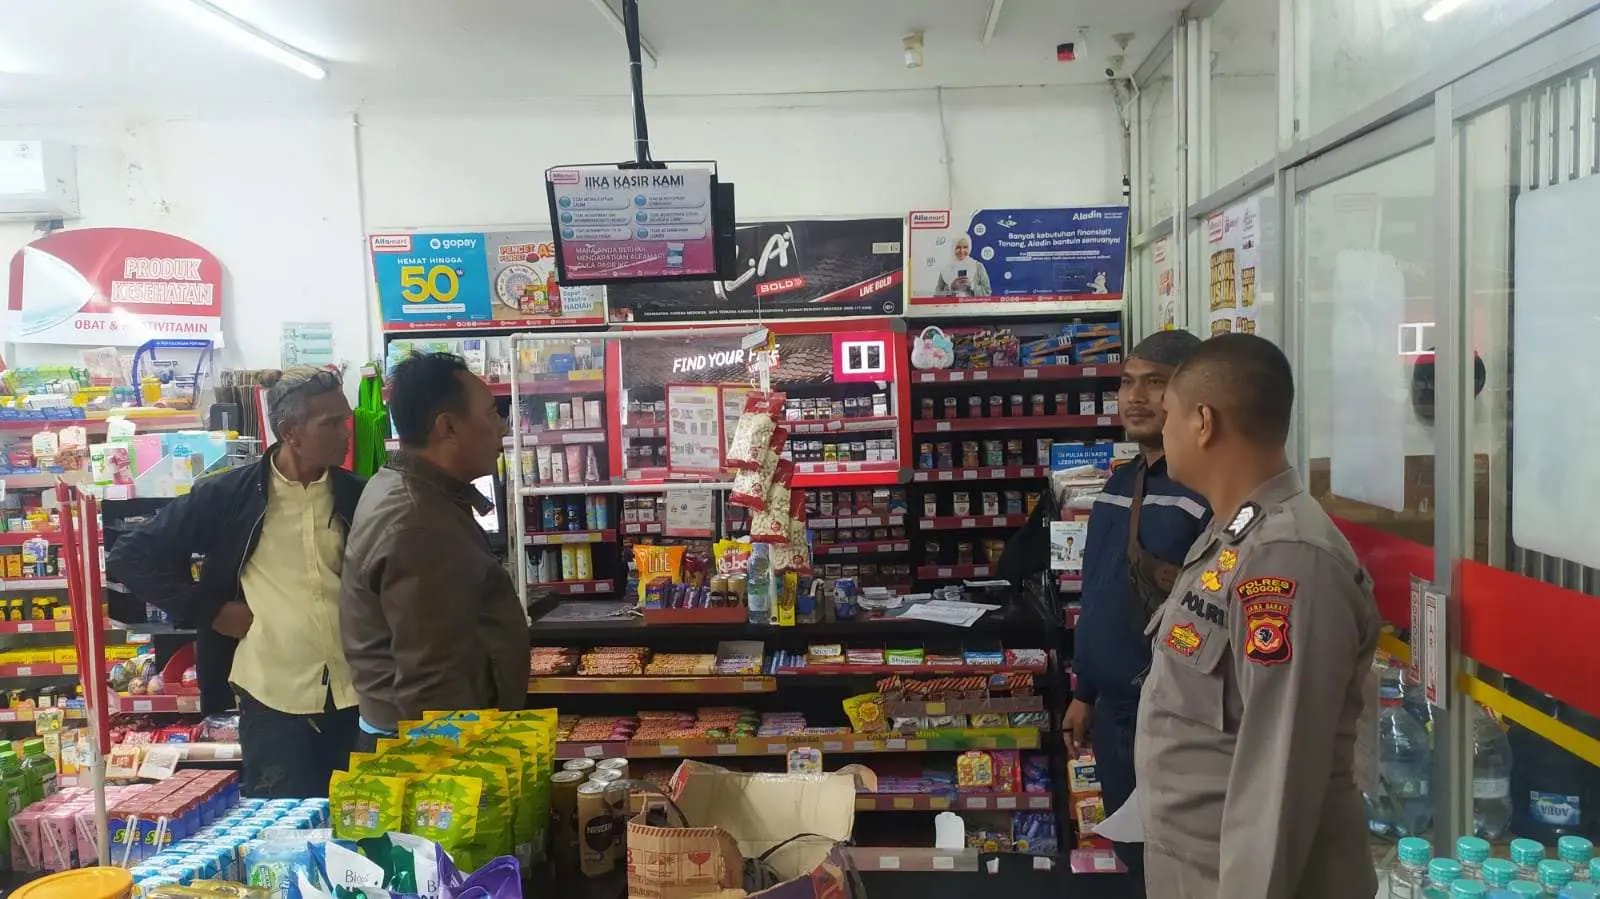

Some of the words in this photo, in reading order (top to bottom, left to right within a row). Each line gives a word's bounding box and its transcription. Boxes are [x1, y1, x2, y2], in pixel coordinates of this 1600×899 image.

[613, 175, 649, 188] KASIR
[653, 175, 684, 186] KAMI
[1072, 210, 1102, 222] Aladin
[1008, 231, 1035, 241] Banyak
[442, 239, 477, 250] gopay
[397, 257, 426, 265] HEMAT
[429, 256, 462, 264] HINGGA
[124, 257, 202, 281] PRODUK
[401, 266, 460, 303] 50
[760, 280, 793, 293] BOLD
[860, 284, 874, 297] LIVE
[110, 281, 214, 305] KESEHATAN
[75, 320, 105, 330] OBAT
[109, 322, 118, 330] &
[672, 355, 706, 374] FIND
[709, 349, 744, 367] YOUR
[1239, 579, 1289, 593] POLRES
